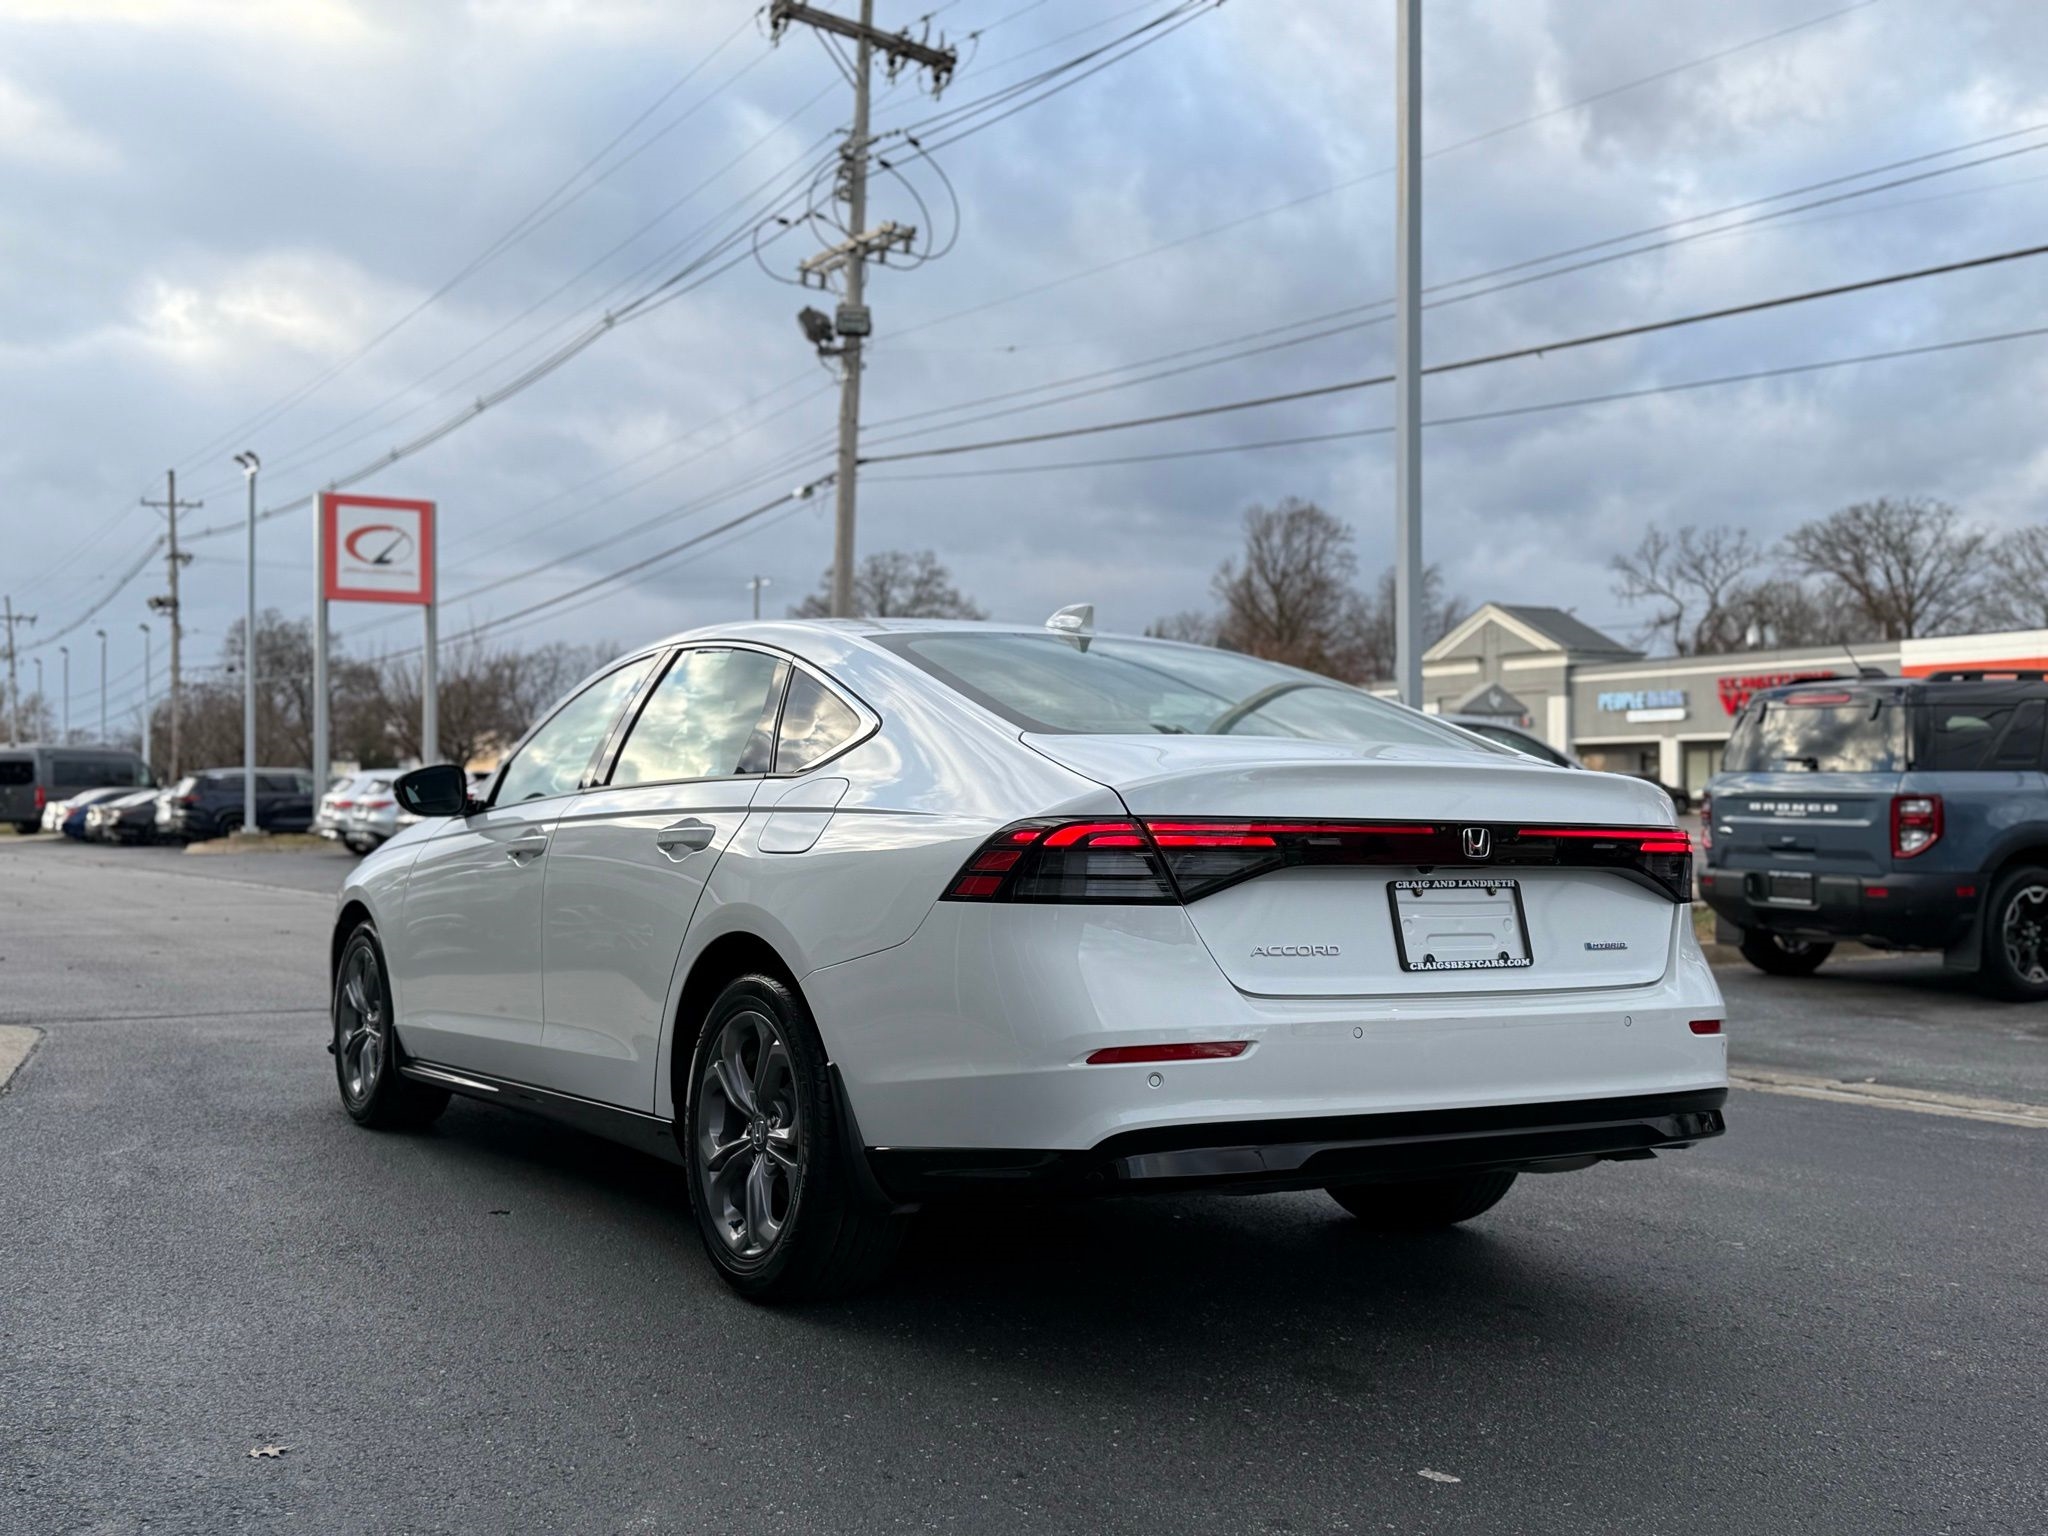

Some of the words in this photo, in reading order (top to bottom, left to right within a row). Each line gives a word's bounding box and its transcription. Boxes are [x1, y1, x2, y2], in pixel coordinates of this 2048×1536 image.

[1395, 880, 1430, 888] CRAIG
[1432, 880, 1456, 888] AND
[1458, 879, 1515, 888] LANDRETH
[1250, 944, 1341, 957] ACCORD
[1409, 958, 1530, 970] CRAIGSBESTCARS.COM
